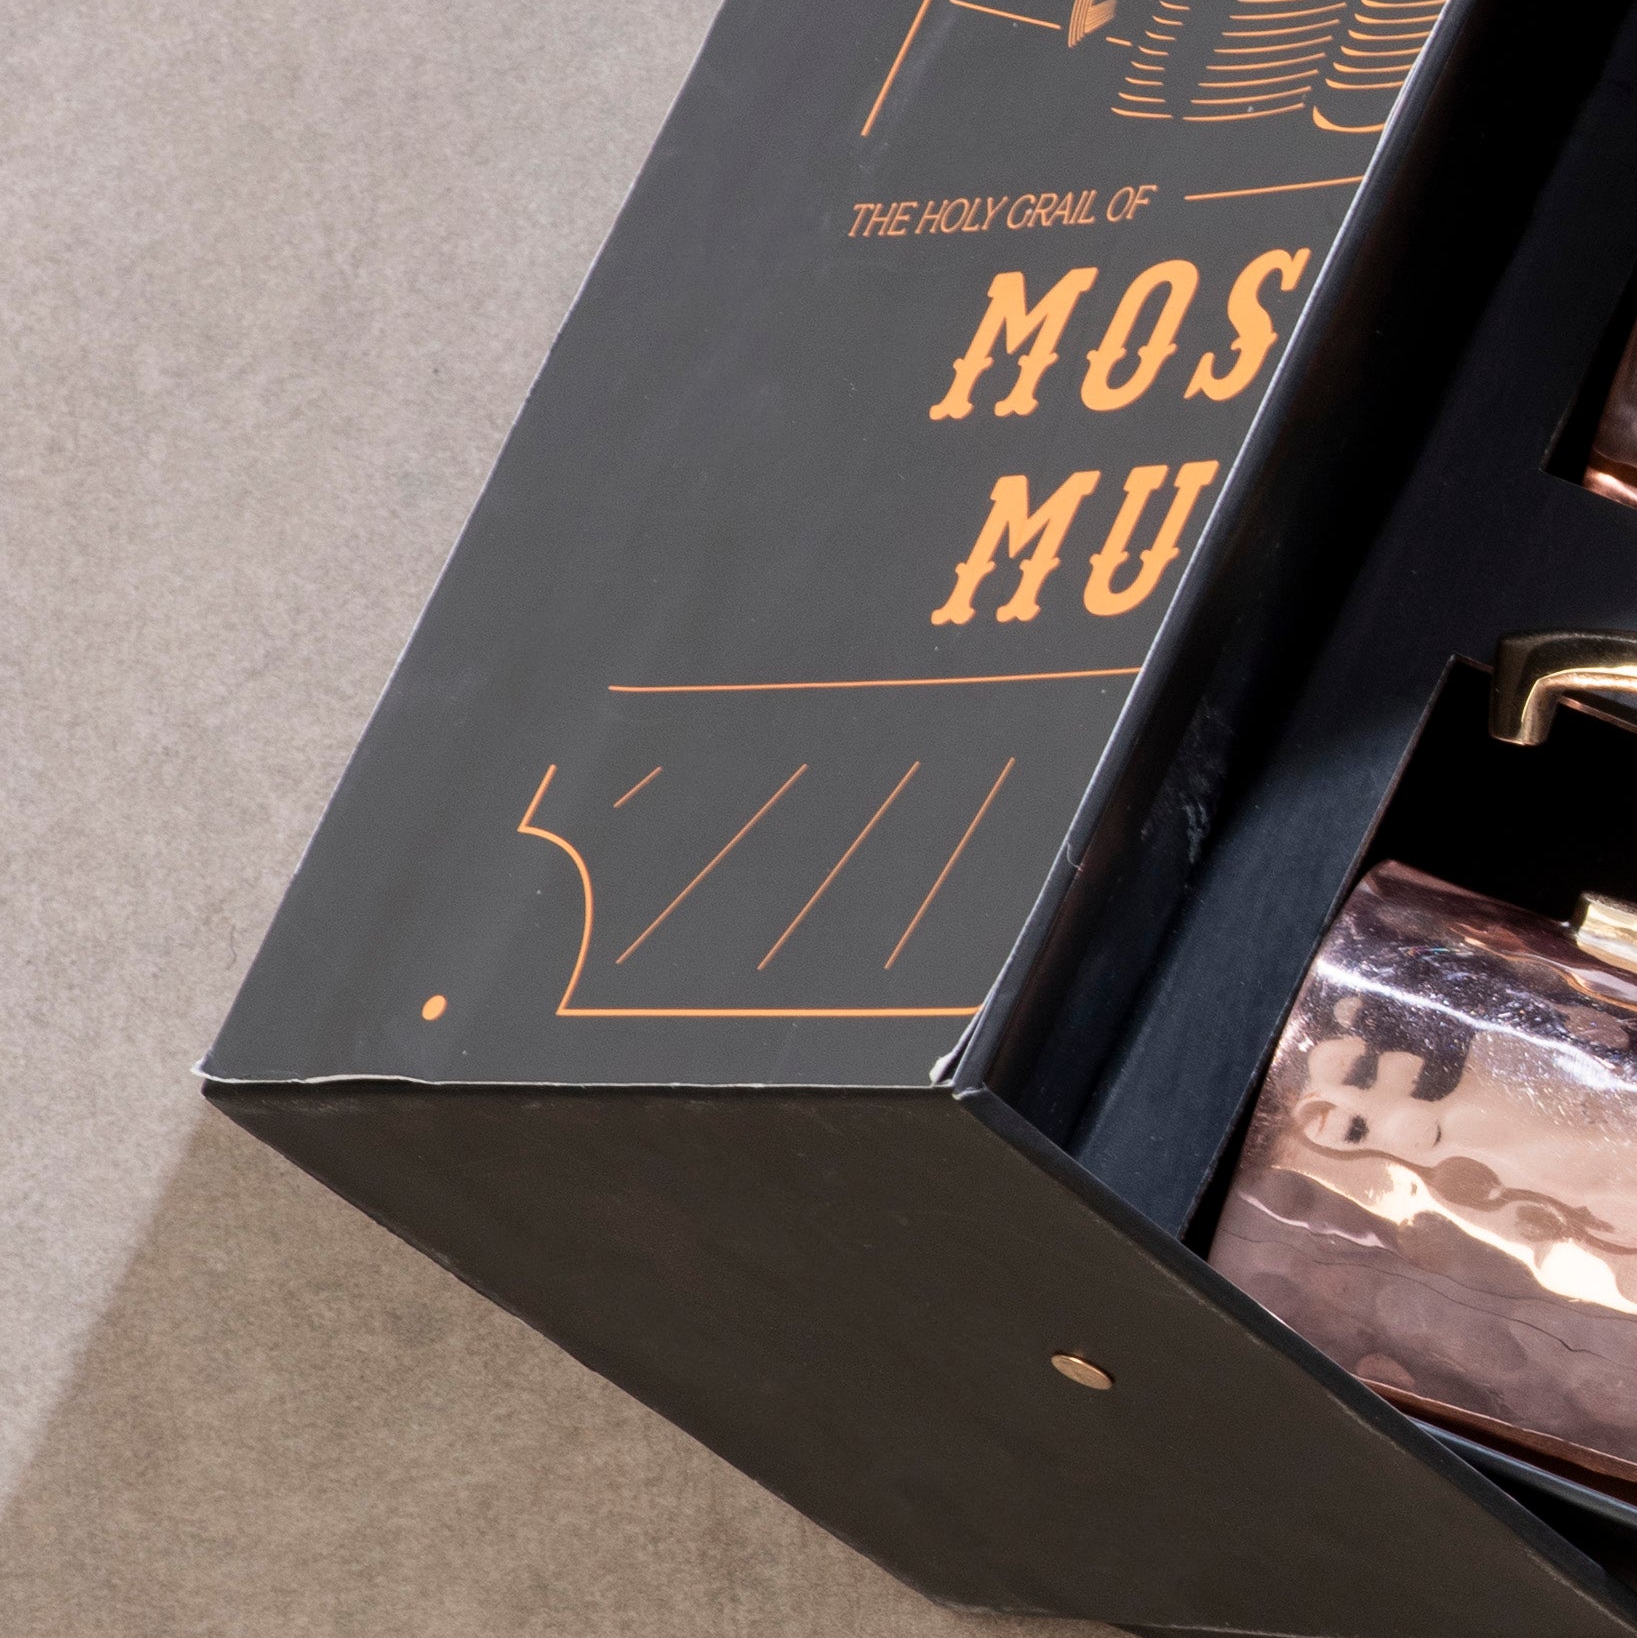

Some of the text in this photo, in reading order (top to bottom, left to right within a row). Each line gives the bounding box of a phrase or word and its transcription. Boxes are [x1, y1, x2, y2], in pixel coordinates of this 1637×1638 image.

[848, 185, 1158, 237] THE HOLY GRAIL OF
[929, 248, 1311, 420] MOS
[931, 460, 1219, 625] MU
